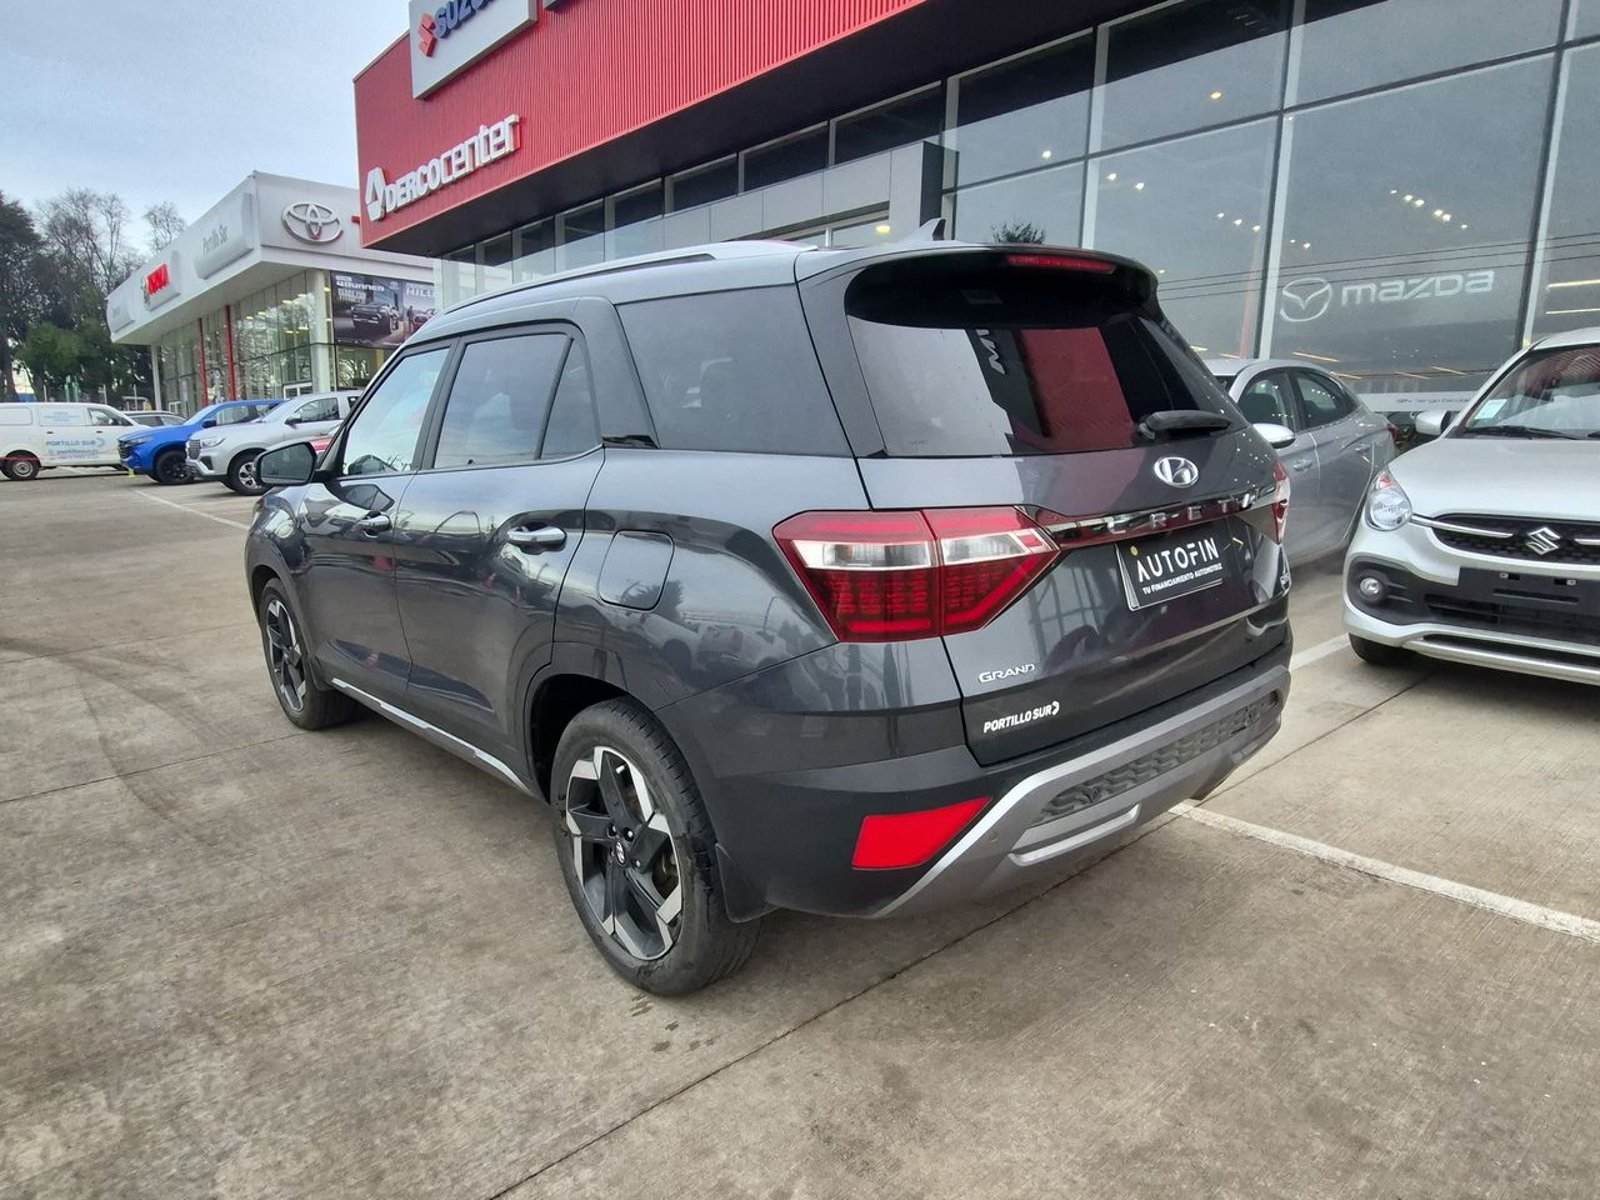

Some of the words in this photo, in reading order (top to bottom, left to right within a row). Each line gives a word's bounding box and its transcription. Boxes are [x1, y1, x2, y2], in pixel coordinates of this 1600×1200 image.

[1136, 537, 1220, 583] AUTOFIN
[1142, 586, 1152, 595] TU
[1151, 572, 1195, 593] FINANCIAMIENTO
[978, 663, 1036, 684] GRAND
[983, 709, 1032, 734] PORTILLO
[1032, 704, 1052, 721] SUR
